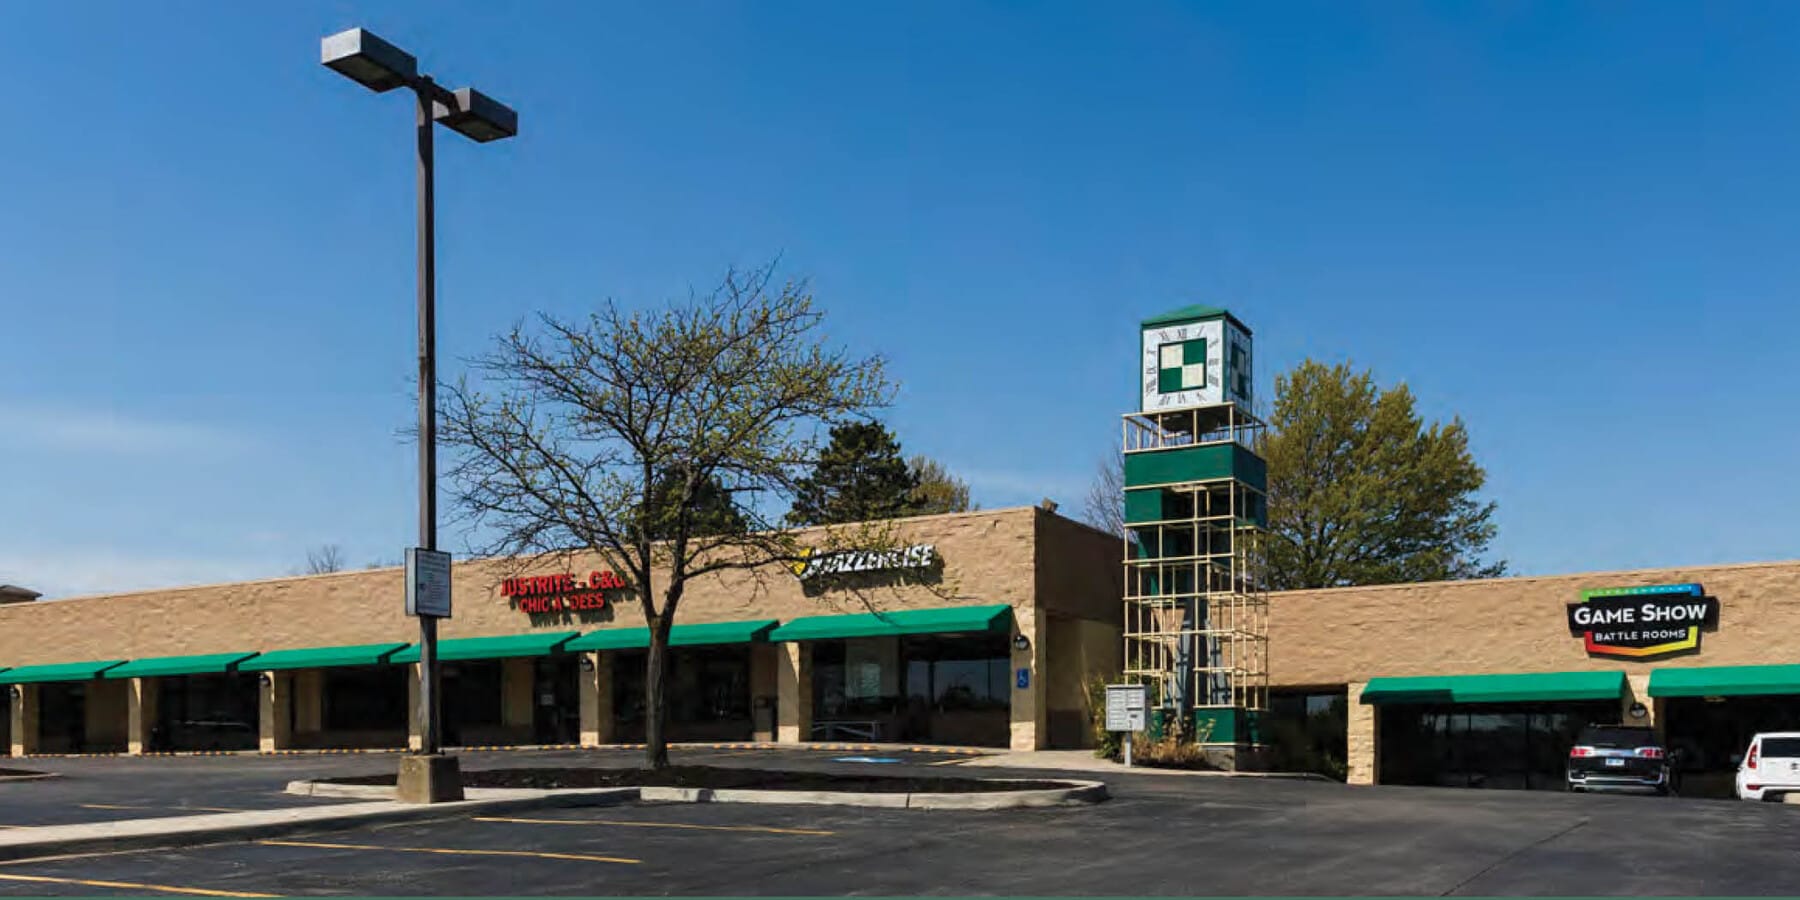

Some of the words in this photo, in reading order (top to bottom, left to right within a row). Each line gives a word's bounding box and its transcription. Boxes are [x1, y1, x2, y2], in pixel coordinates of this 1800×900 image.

[501, 573, 574, 596] JUSTRITE
[519, 596, 549, 613] CHIC
[570, 593, 604, 610] DEES
[1574, 607, 1635, 624] GAME
[1641, 604, 1707, 622] SHOW
[1595, 631, 1638, 642] BATTLE
[1643, 629, 1686, 640] ROOMS
